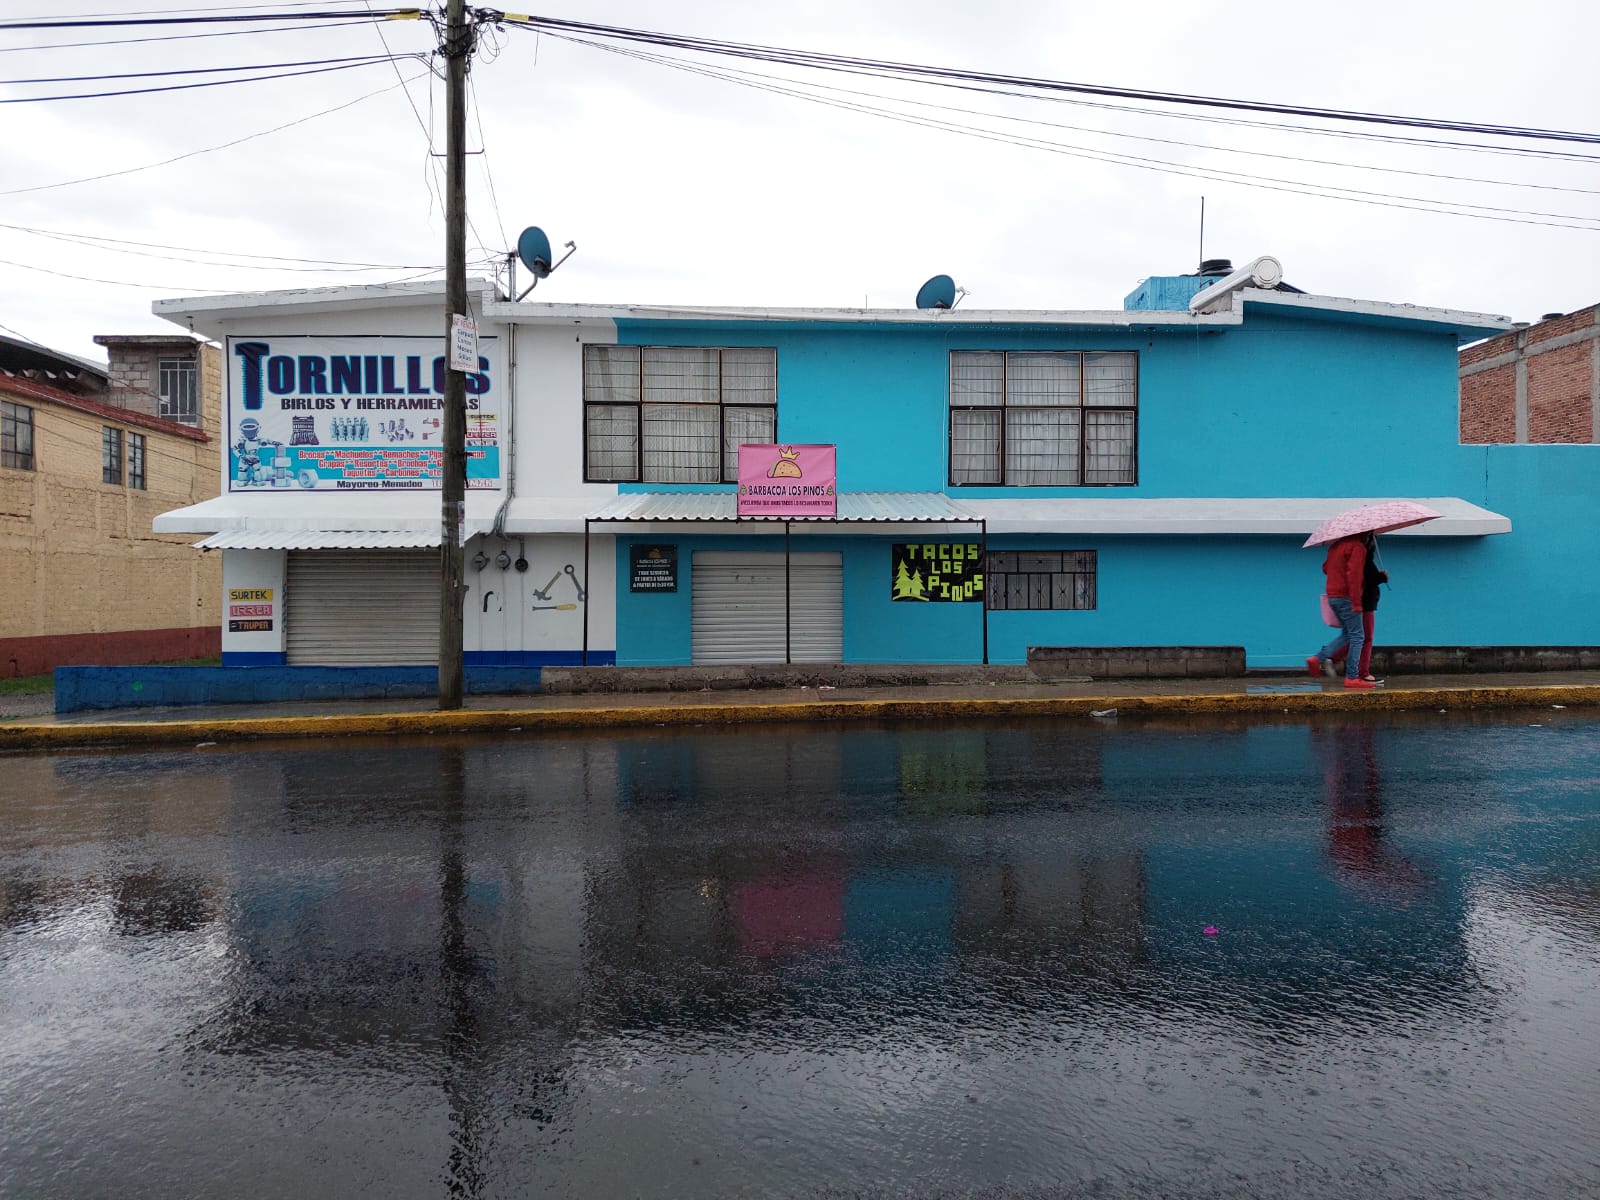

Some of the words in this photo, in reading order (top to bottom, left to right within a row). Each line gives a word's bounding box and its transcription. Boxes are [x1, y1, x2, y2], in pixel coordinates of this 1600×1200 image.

[281, 398, 336, 411] BIRLOS
[342, 398, 352, 410] Y
[356, 398, 479, 410] HERRAMIENS
[749, 486, 786, 495] BARBACOA
[788, 486, 801, 495] LOS
[804, 486, 824, 495] PINOS
[906, 544, 978, 560] TACOS
[931, 560, 963, 574] LOS
[928, 574, 984, 602] PINOS
[231, 590, 267, 600] SURTEK
[238, 621, 269, 630] TRUPER
